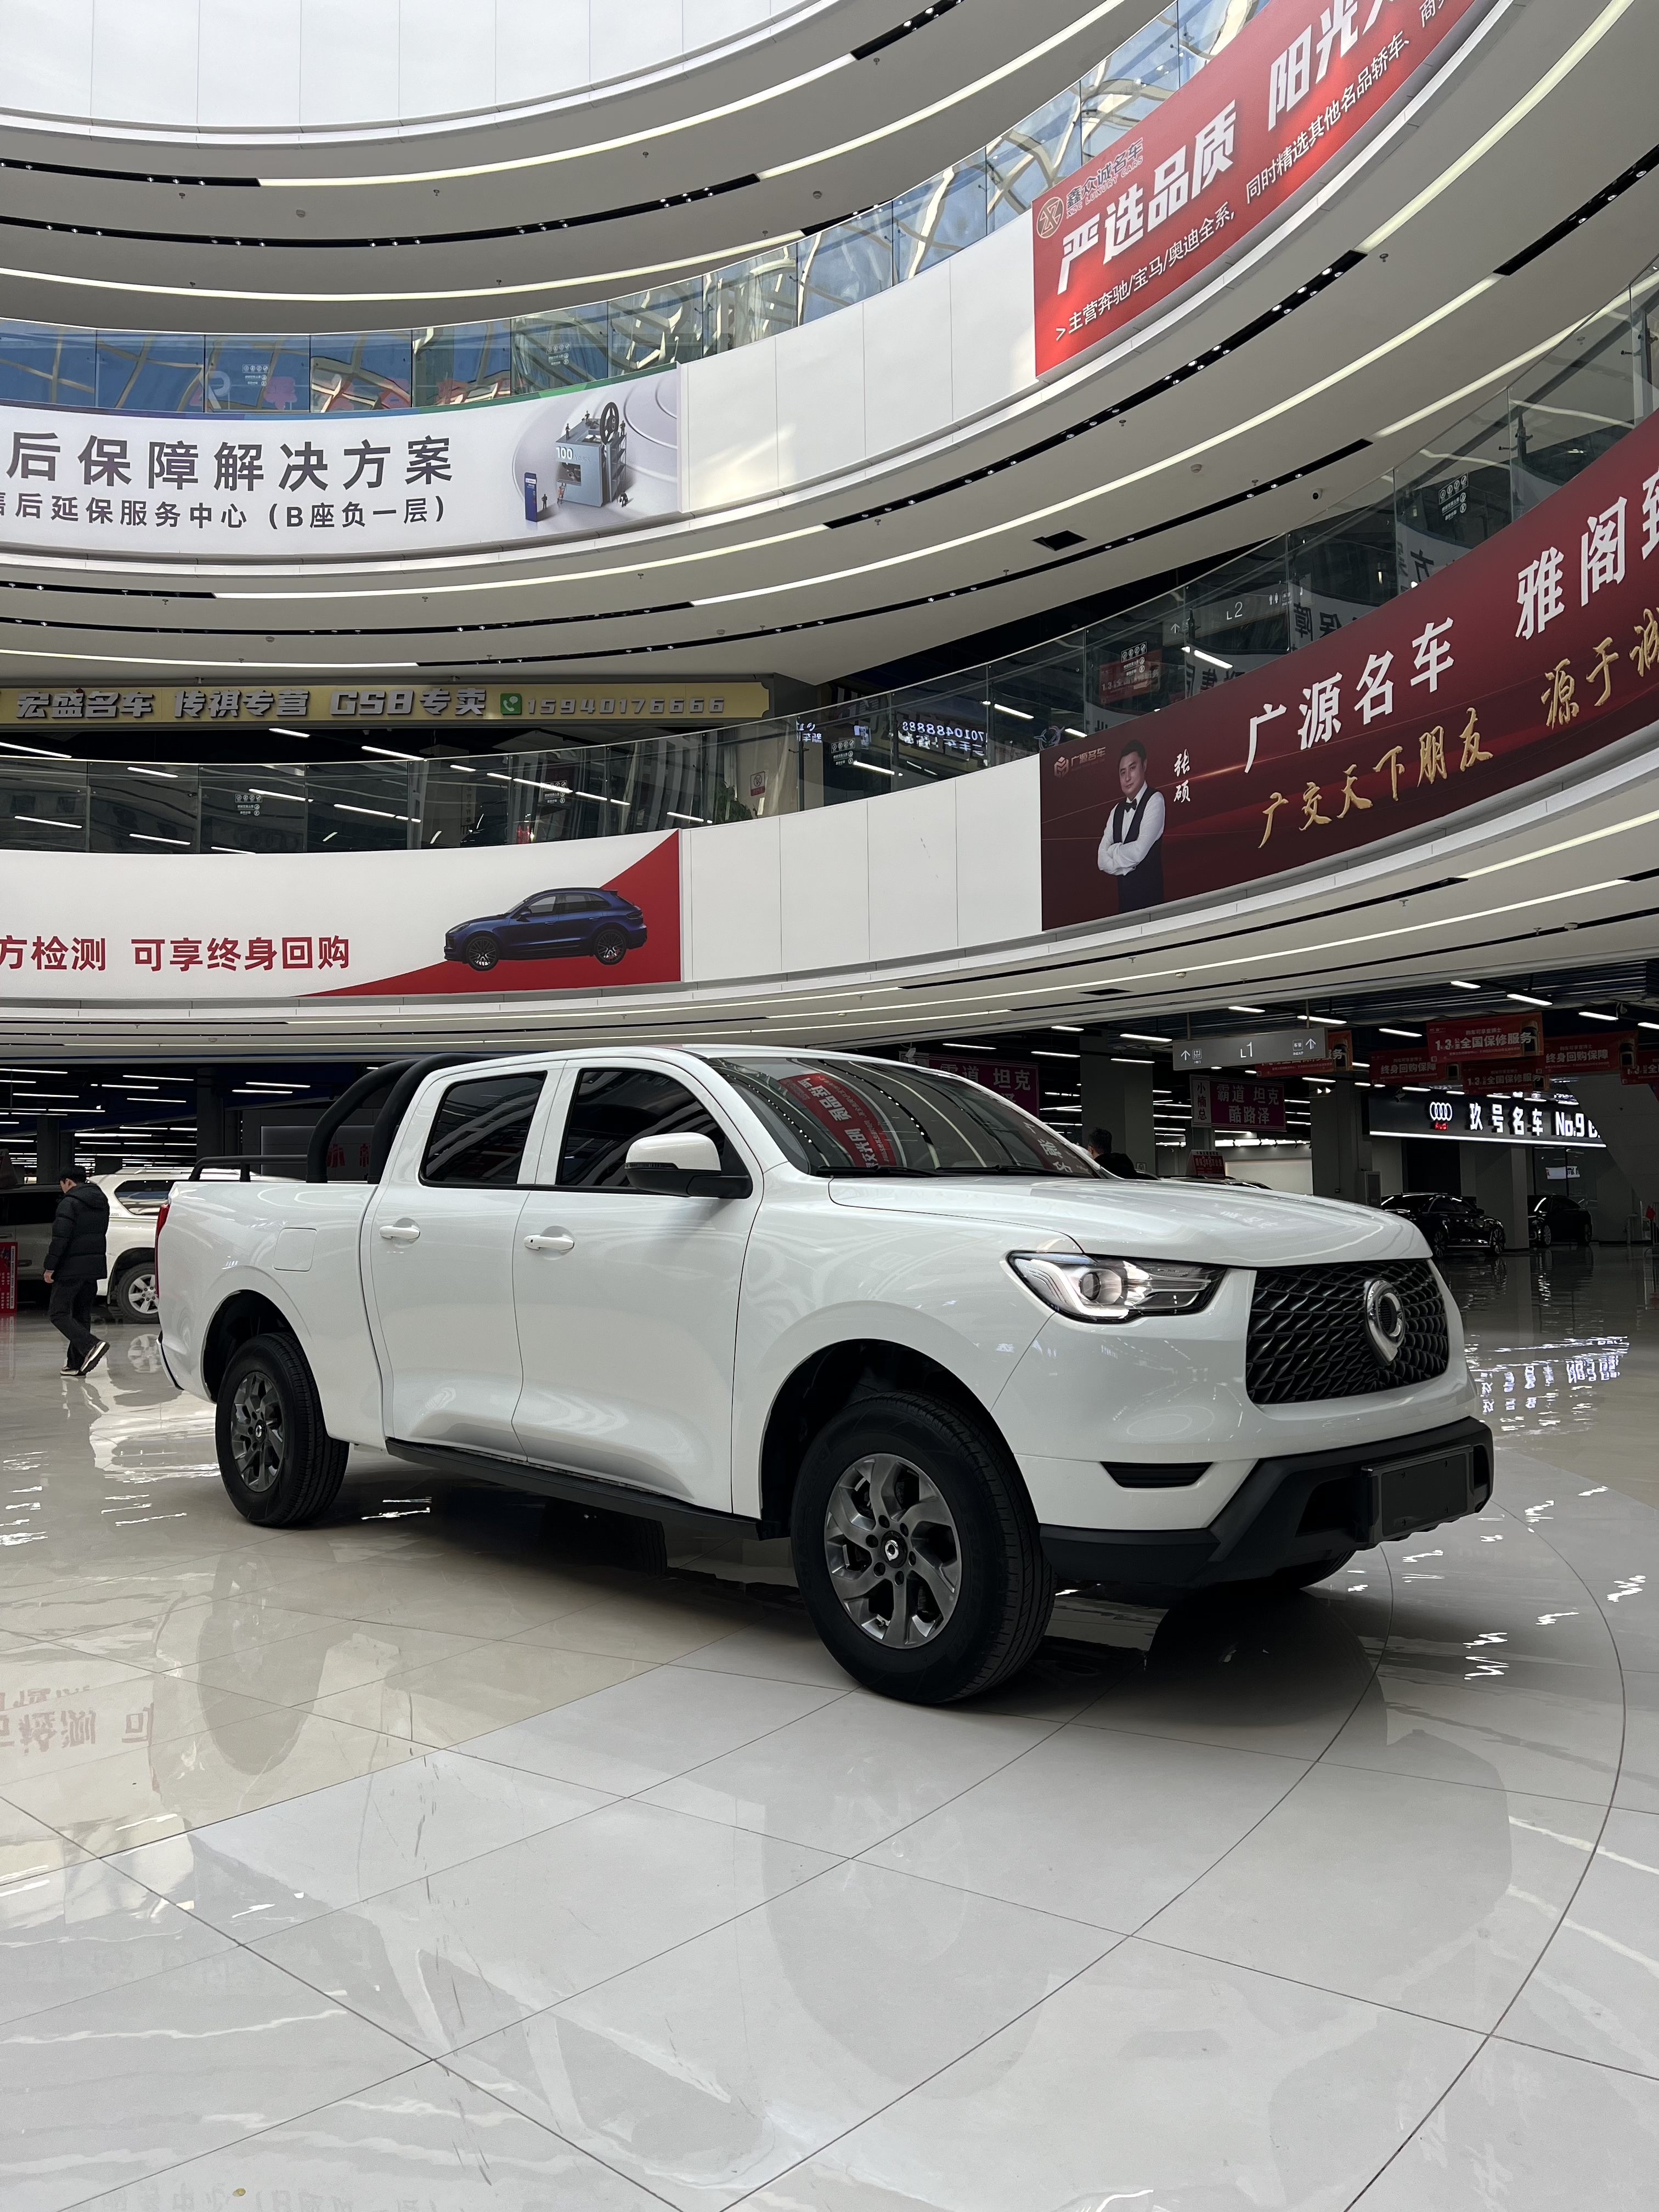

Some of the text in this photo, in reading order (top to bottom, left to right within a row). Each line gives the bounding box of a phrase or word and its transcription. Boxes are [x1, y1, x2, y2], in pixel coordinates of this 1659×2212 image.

[1057, 0, 1385, 295] 严选品质 阳光
[1066, 137, 1143, 211] 鑫众诚名车
[1085, 175, 1118, 205] LUXURY
[1121, 155, 1143, 178] CARS
[5, 432, 452, 492] 后保障解决方案
[556, 447, 573, 460] 100
[0, 492, 445, 530] 后延保服务中心（B座负一层）
[1227, 601, 1243, 620] L2
[16, 689, 154, 719] 宏盛名车
[174, 688, 311, 718] 传祺专营
[527, 697, 724, 714] 15940176666
[1245, 617, 1455, 773] 广源名车
[1071, 747, 1106, 766] 广源名车
[1173, 749, 1190, 803] 张硕
[1258, 707, 1493, 848] 广交天下朋友
[0, 935, 349, 972] 方检测 可享终身回购
[1240, 1041, 1253, 1058] L1
[1545, 1049, 1609, 1063] 终身回购保障
[993, 1068, 1031, 1091] 坦克
[1381, 1062, 1436, 1074] 终身回购保障
[1216, 1084, 1279, 1105] 霸道 坦克
[1228, 1105, 1269, 1125] 酷路泽
[1469, 1103, 1543, 1136] 玖号名车
[1556, 1111, 1584, 1137] No.9
